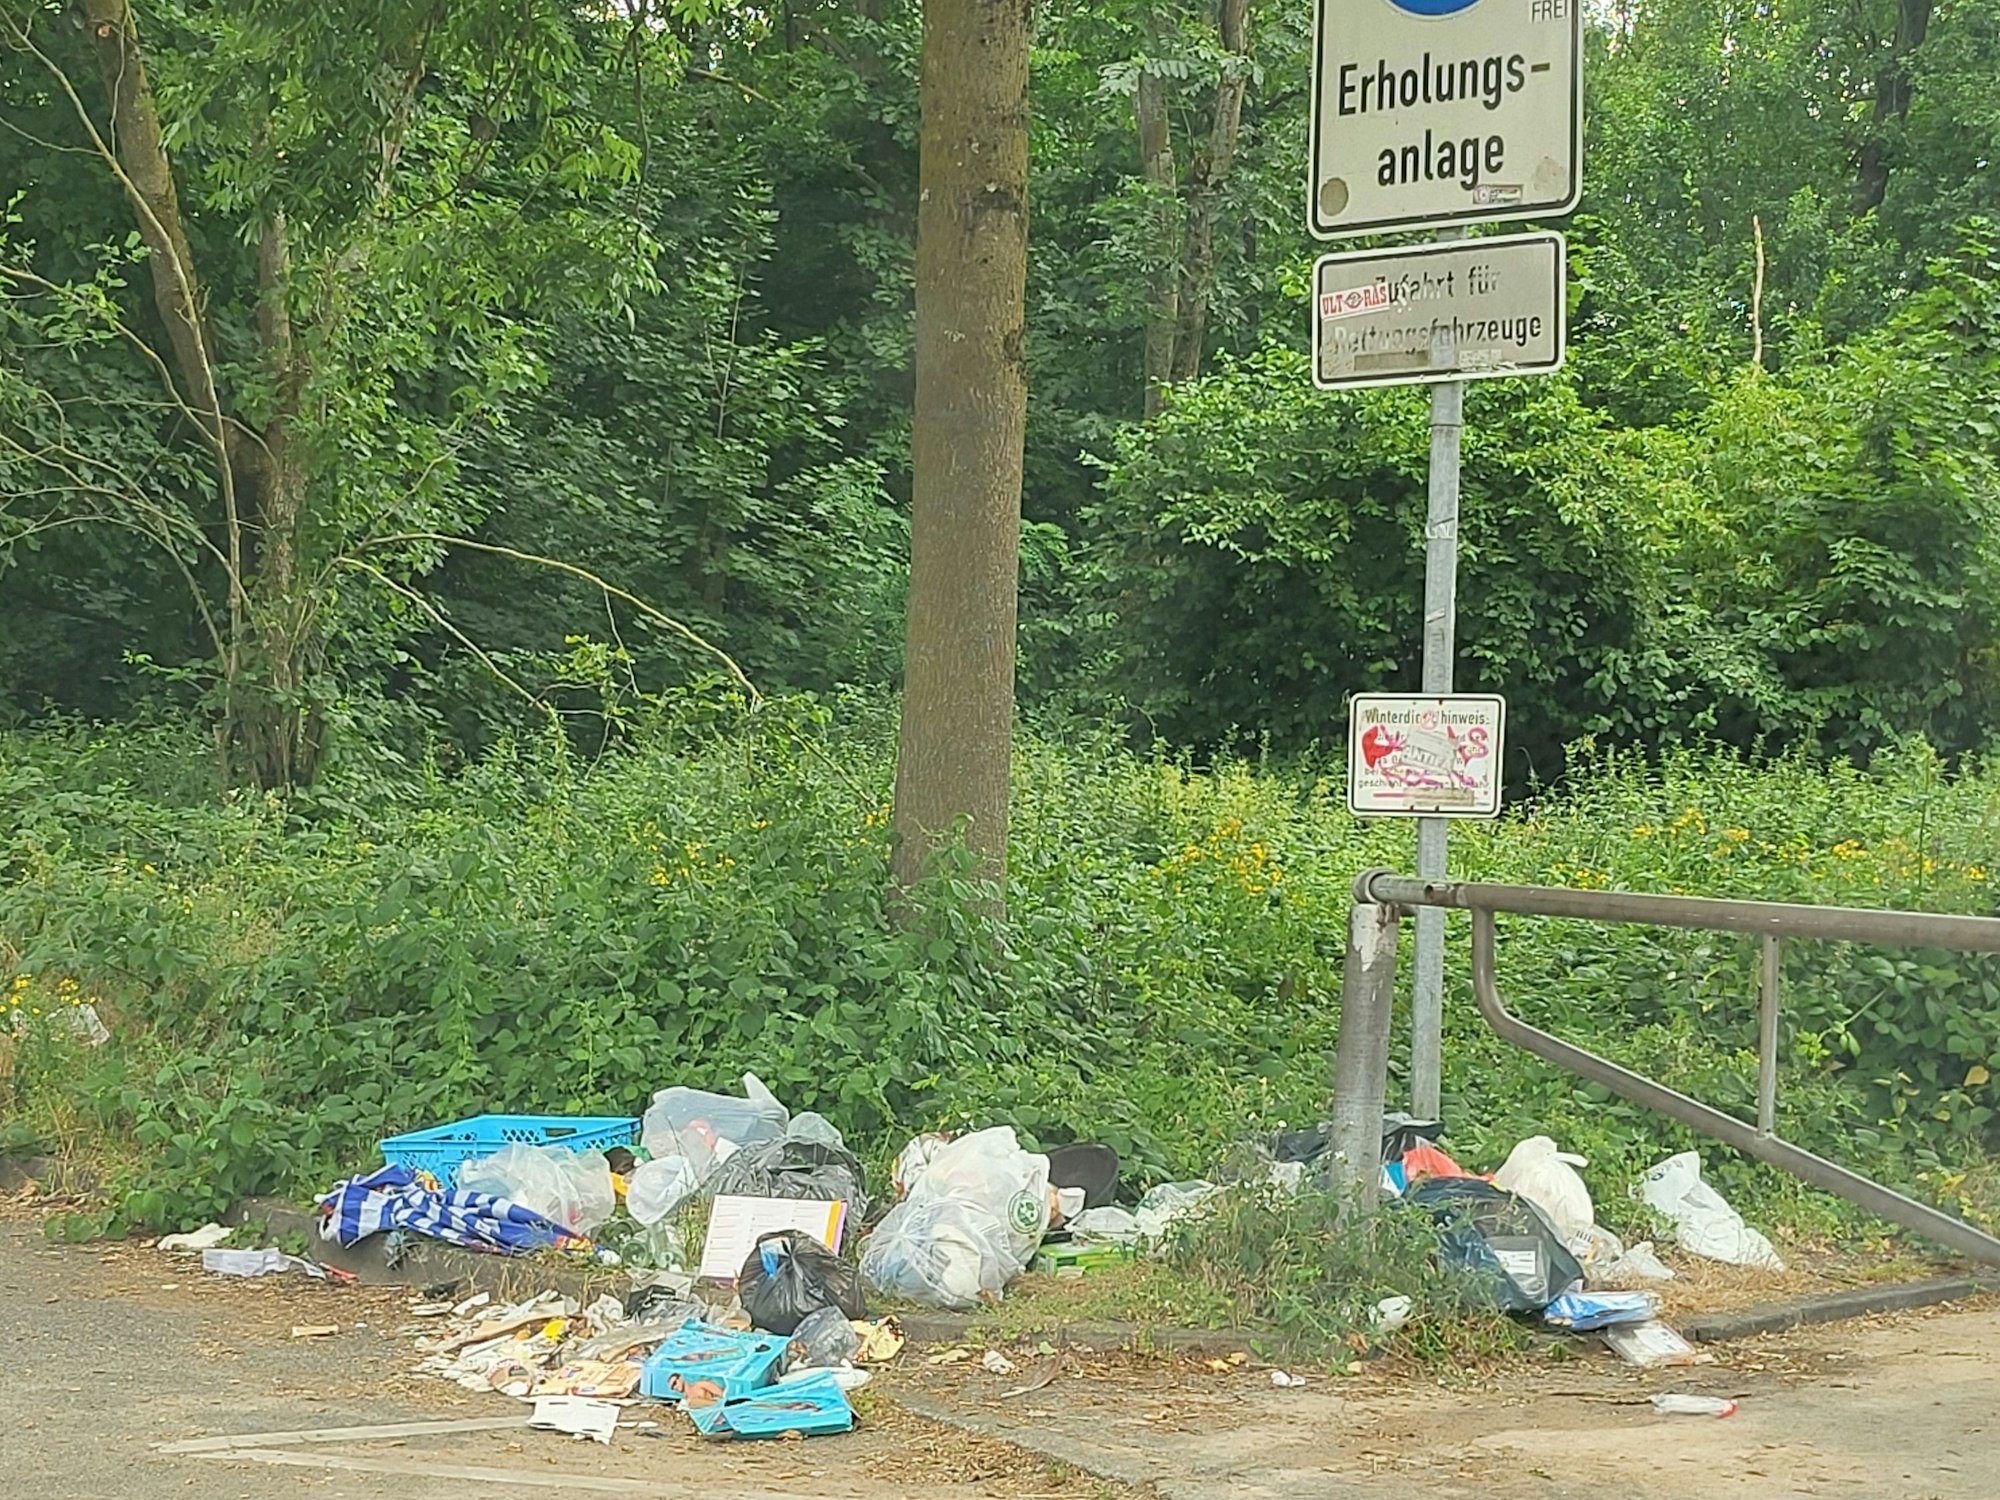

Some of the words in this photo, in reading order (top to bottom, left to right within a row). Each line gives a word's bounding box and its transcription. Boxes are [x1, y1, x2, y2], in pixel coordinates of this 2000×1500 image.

[1531, 0, 1568, 22] FREI
[1338, 52, 1551, 117] Erholungs-
[1377, 128, 1505, 191] anlage
[1375, 270, 1454, 304] ufahrt
[1467, 264, 1501, 295] für
